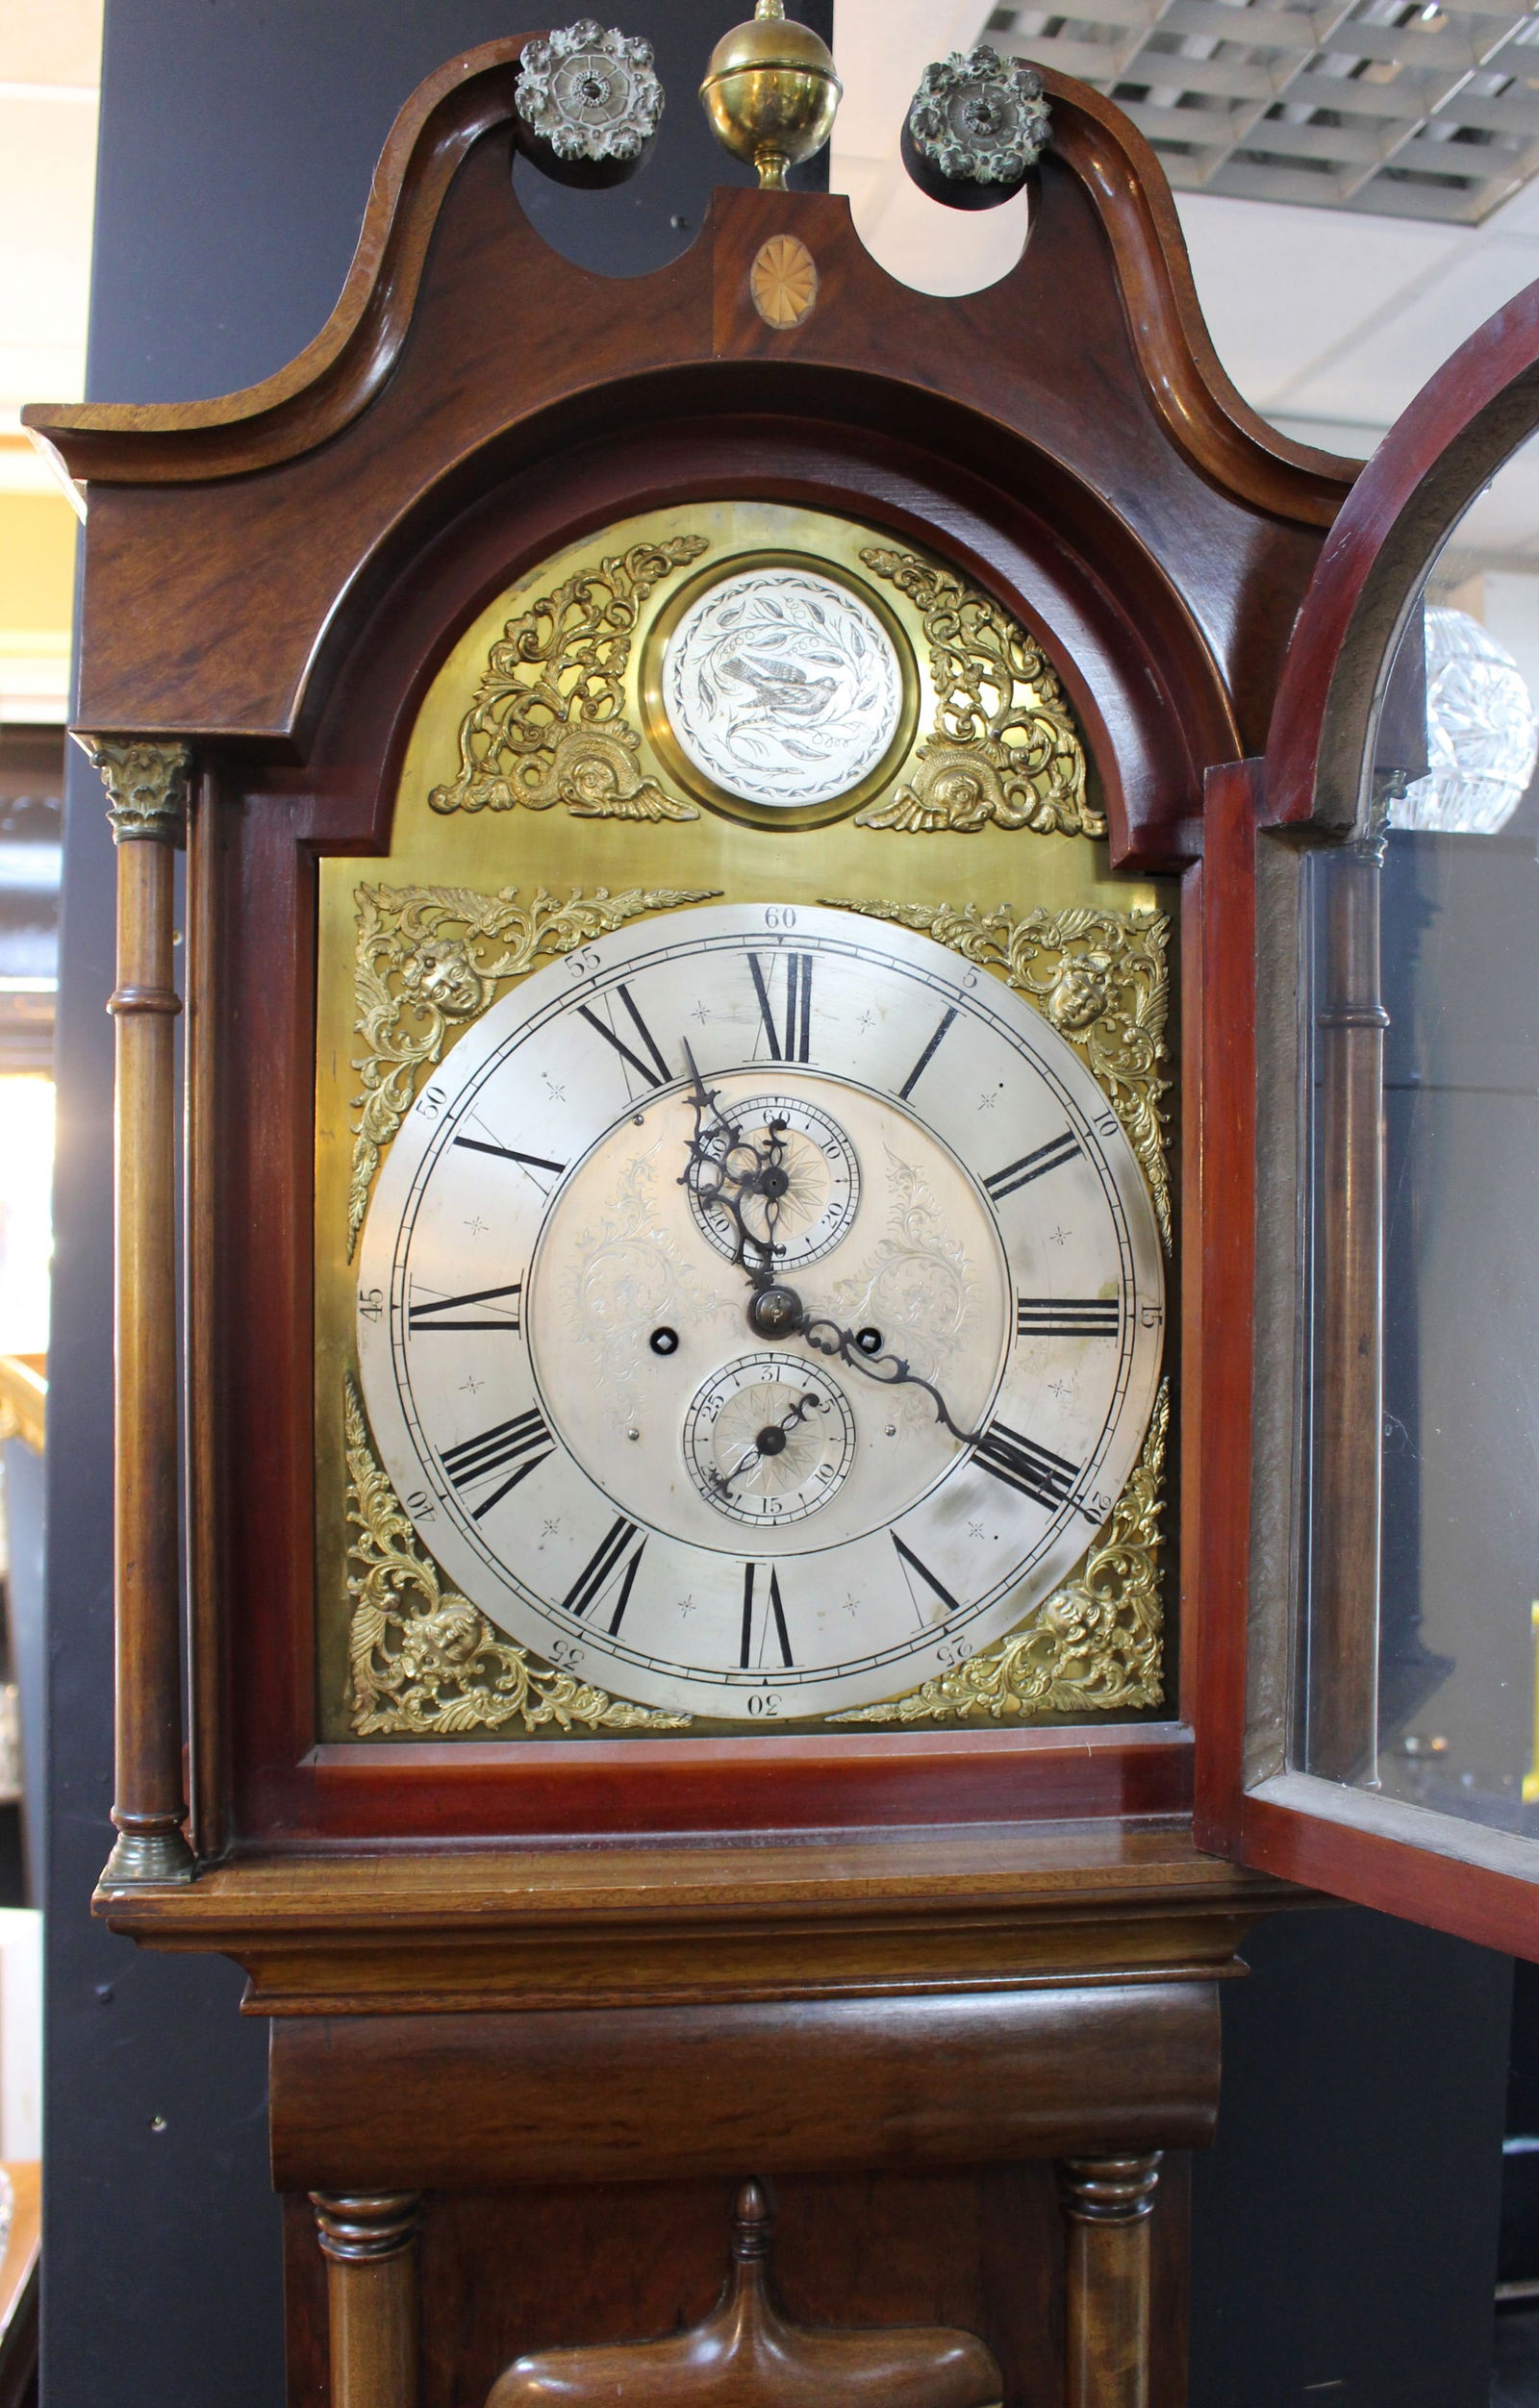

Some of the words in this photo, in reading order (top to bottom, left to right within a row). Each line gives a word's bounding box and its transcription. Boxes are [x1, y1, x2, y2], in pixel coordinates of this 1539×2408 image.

[764, 906, 796, 929] 60
[564, 945, 601, 979] 55
[962, 965, 981, 989] 5
[743, 952, 825, 1065] XII
[568, 980, 685, 1110] XI
[888, 999, 967, 1107] I
[416, 1086, 447, 1120] 50
[763, 1109, 791, 1126] 60
[1092, 1110, 1119, 1138] 10
[446, 1102, 571, 1208] X
[820, 1136, 841, 1160] 10
[977, 1120, 1087, 1214] II
[821, 1203, 843, 1229] 20
[360, 1288, 384, 1322] 45
[409, 1268, 524, 1341] IX
[1015, 1284, 1120, 1348] III
[1142, 1305, 1162, 1329] 15
[761, 1366, 781, 1382] 31
[701, 1395, 724, 1423] 25
[819, 1398, 837, 1415] 5
[435, 1397, 557, 1531] VIII
[814, 1464, 834, 1485] 10
[962, 1411, 1087, 1525] IIII
[405, 1491, 437, 1523] 40
[761, 1497, 783, 1514] 15
[1083, 1492, 1112, 1525] 20
[550, 1509, 649, 1642] VII
[889, 1528, 970, 1634] V
[728, 1562, 805, 1669] VI
[547, 1639, 586, 1670] 35
[936, 1635, 972, 1668] 25
[747, 1694, 782, 1717] 30
